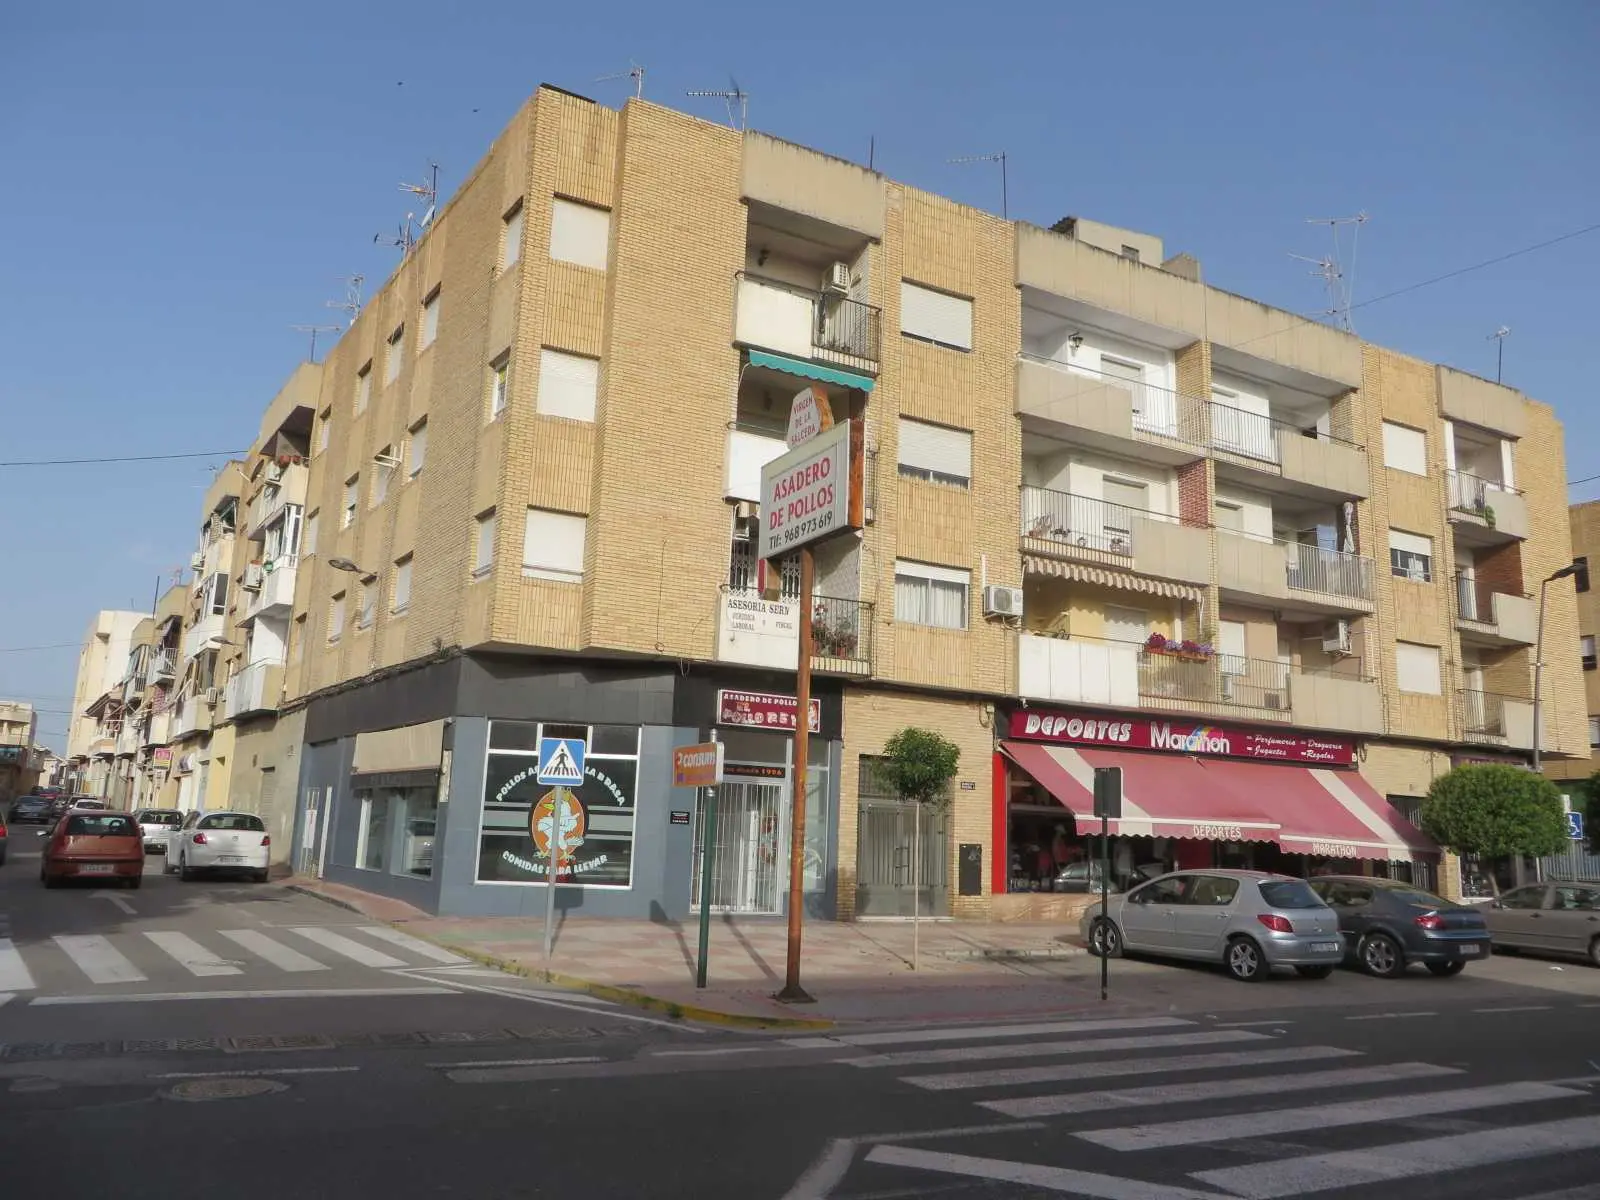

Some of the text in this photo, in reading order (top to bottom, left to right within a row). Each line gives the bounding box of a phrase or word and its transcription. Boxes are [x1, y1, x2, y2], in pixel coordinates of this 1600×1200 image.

[793, 395, 813, 414] VIRGEN
[795, 411, 812, 429] DE LA
[791, 424, 816, 444] SALCEDA
[773, 457, 831, 503] ASADERO
[769, 483, 834, 531] DE POLLOS
[784, 525, 800, 545] 968
[801, 517, 817, 537] 973
[818, 510, 833, 529] 619
[728, 599, 767, 613] ASESORIA
[723, 693, 798, 707] ASADERO DE POLLO
[722, 708, 765, 725] POLLO
[1025, 714, 1132, 742] DEPORTES
[1150, 721, 1230, 753] Marathon
[1254, 745, 1335, 761] Juguetes Regalos
[496, 771, 527, 802] POLLOS
[584, 766, 596, 777] LA
[596, 771, 625, 806] BRASA
[1193, 823, 1241, 840] DEPORTES
[1312, 842, 1357, 857] MARATHON
[502, 850, 544, 874] COMIDAS
[573, 854, 608, 872] LLEVAR
